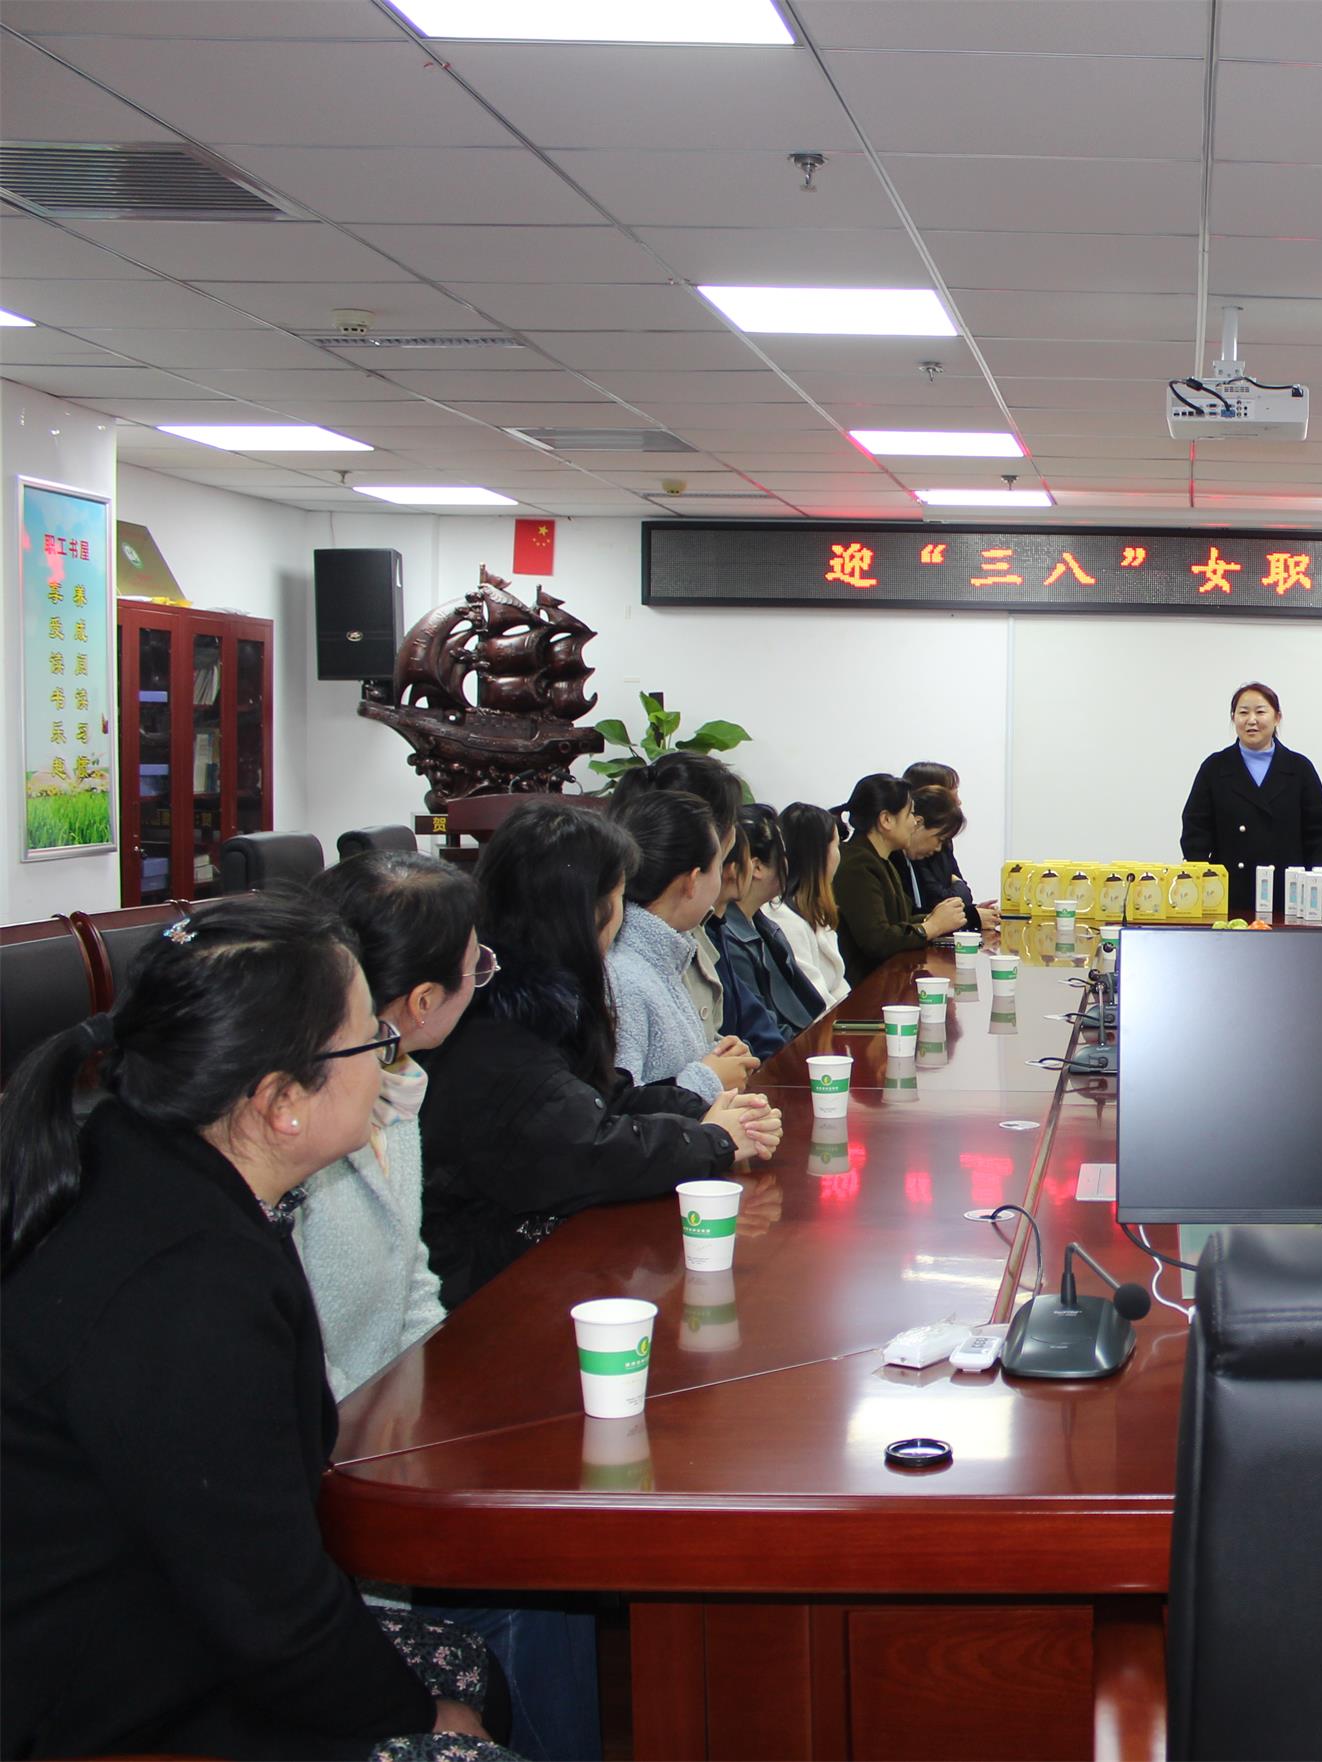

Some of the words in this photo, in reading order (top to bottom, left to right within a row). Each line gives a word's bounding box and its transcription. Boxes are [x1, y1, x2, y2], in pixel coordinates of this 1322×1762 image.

[44, 533, 90, 561] 职工书屋
[432, 816, 447, 832] 贺
